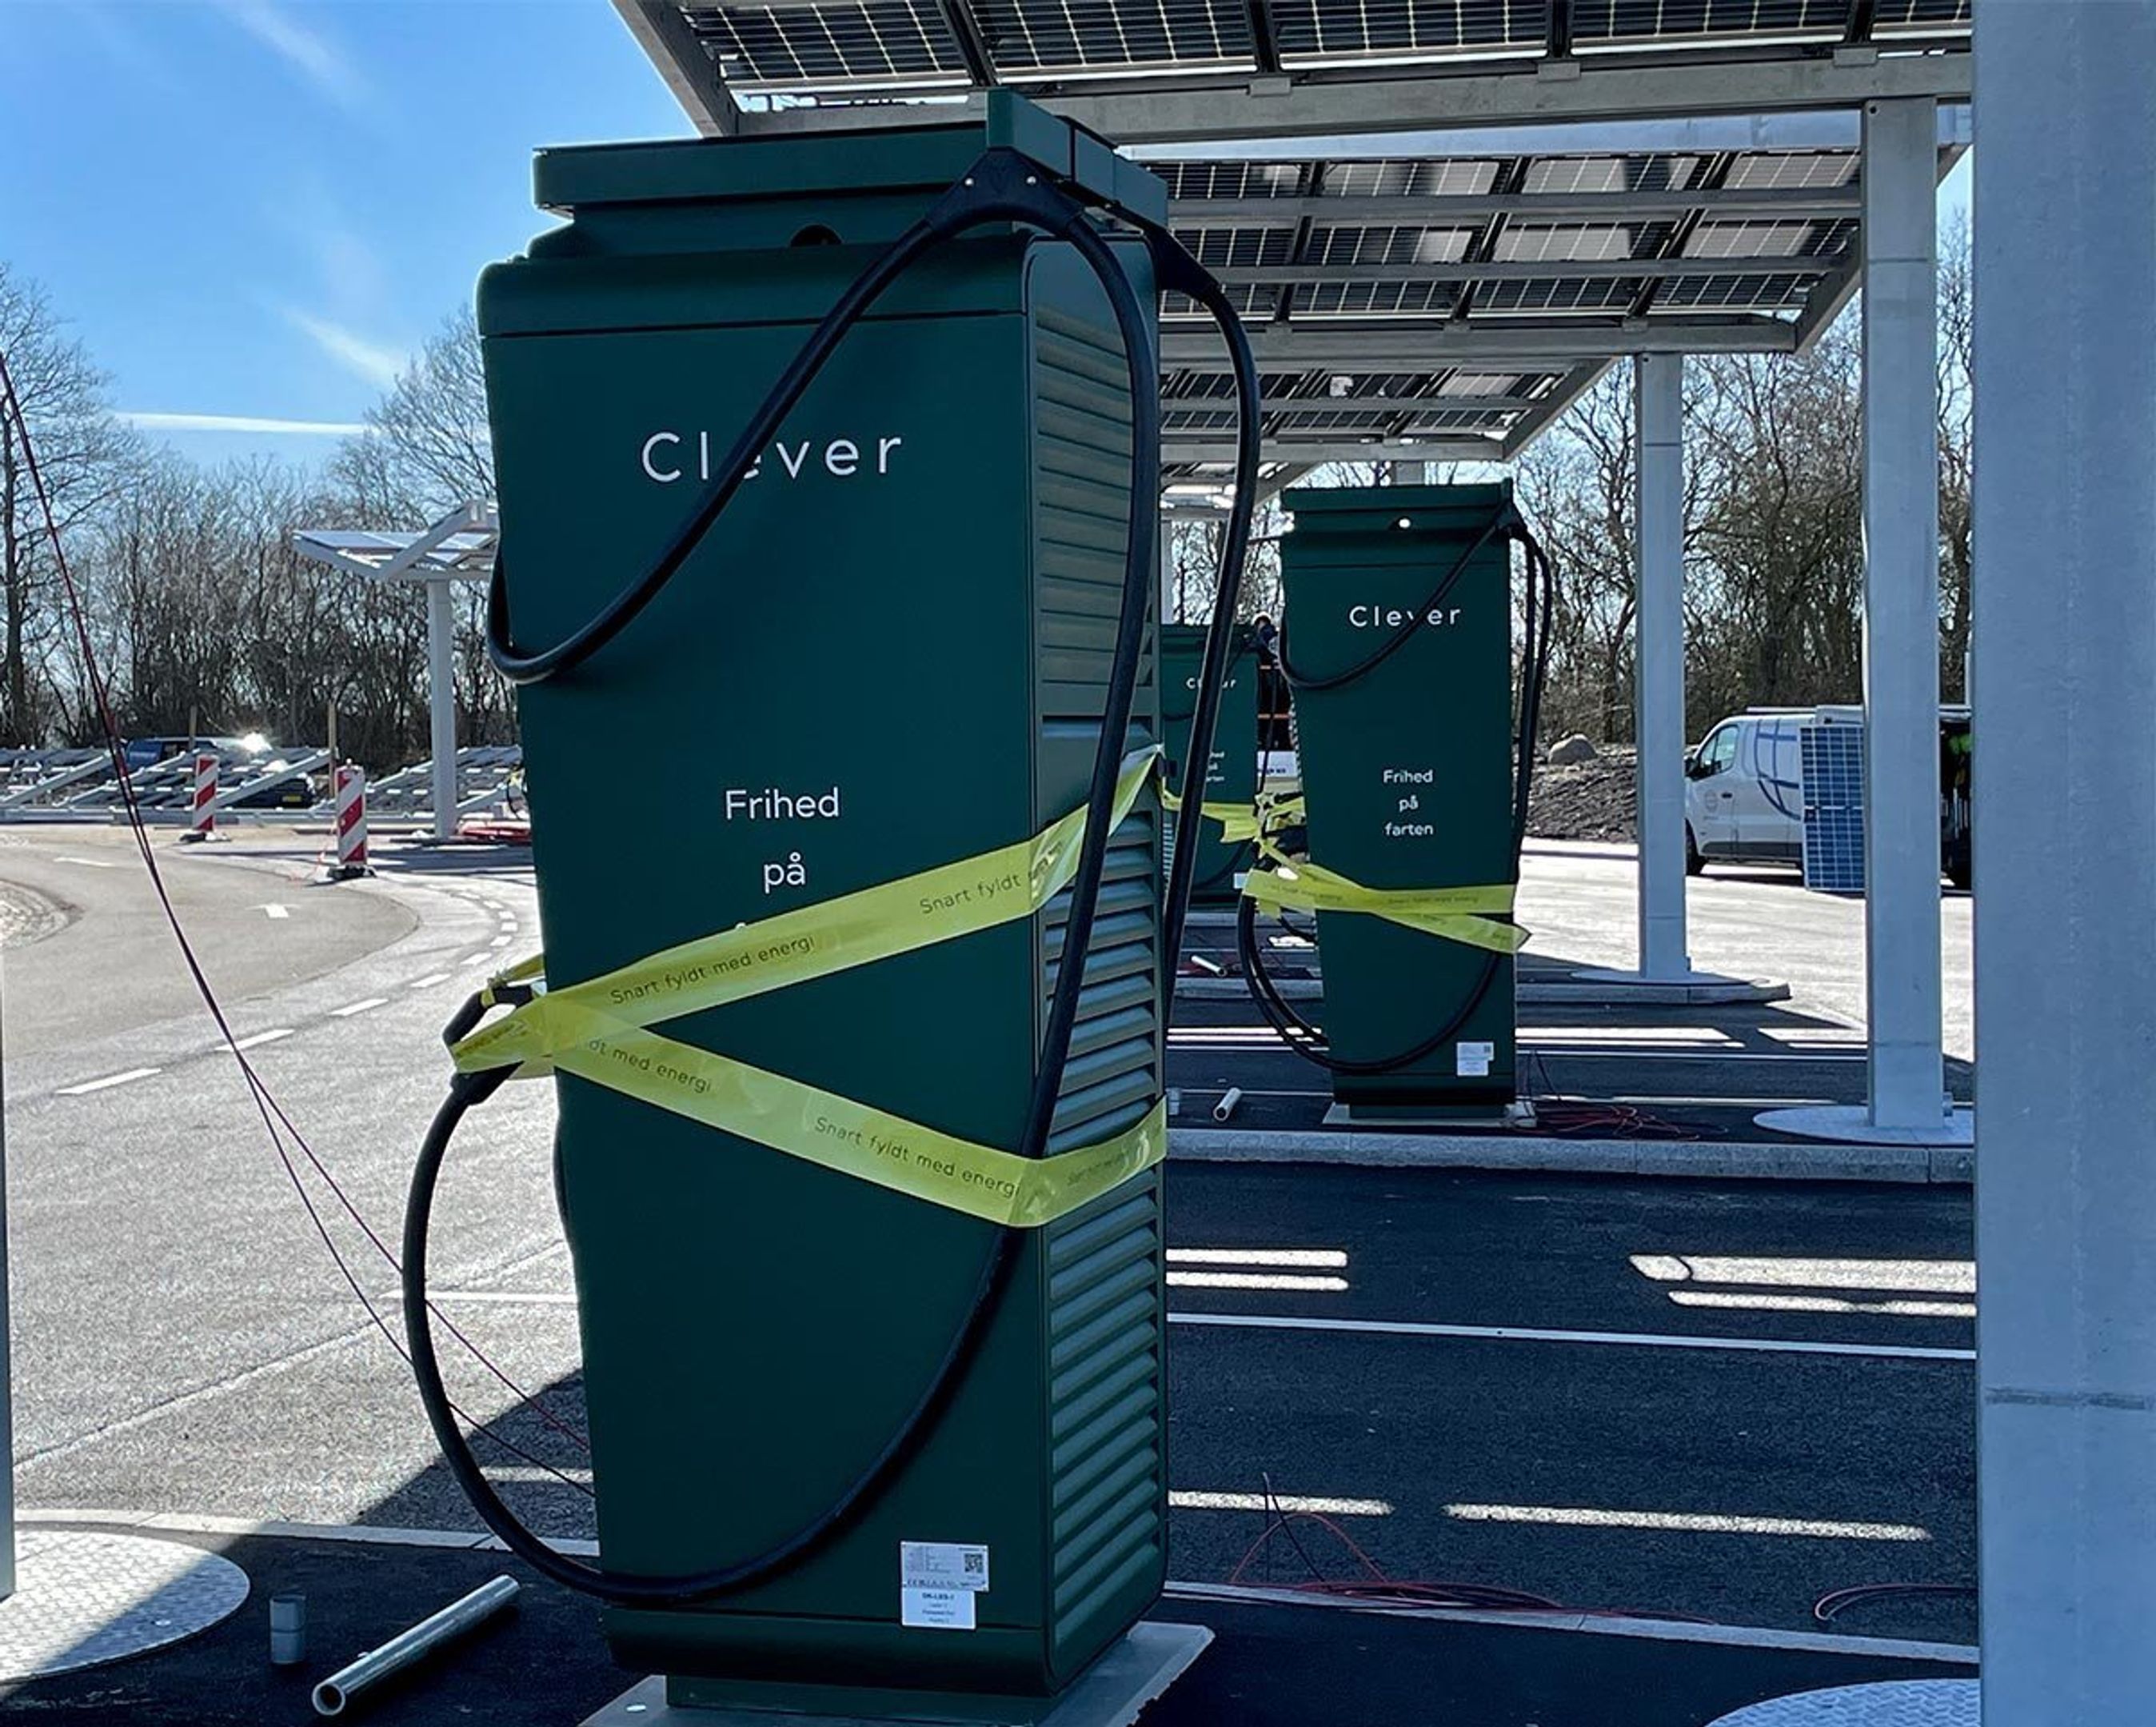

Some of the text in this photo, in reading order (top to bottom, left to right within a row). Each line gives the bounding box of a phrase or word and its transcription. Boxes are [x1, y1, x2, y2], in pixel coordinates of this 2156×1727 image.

[1383, 770, 1433, 783] Frihed
[725, 786, 840, 820] Frihed
[1399, 794, 1419, 813] på
[1384, 822, 1434, 837] farten
[764, 851, 806, 894] på
[920, 874, 1021, 913] Snart fyldt
[610, 935, 815, 1004] Snart fyldt med energi
[613, 1048, 712, 1093] med energi
[815, 1117, 1020, 1198] Snart fyldt med energi
